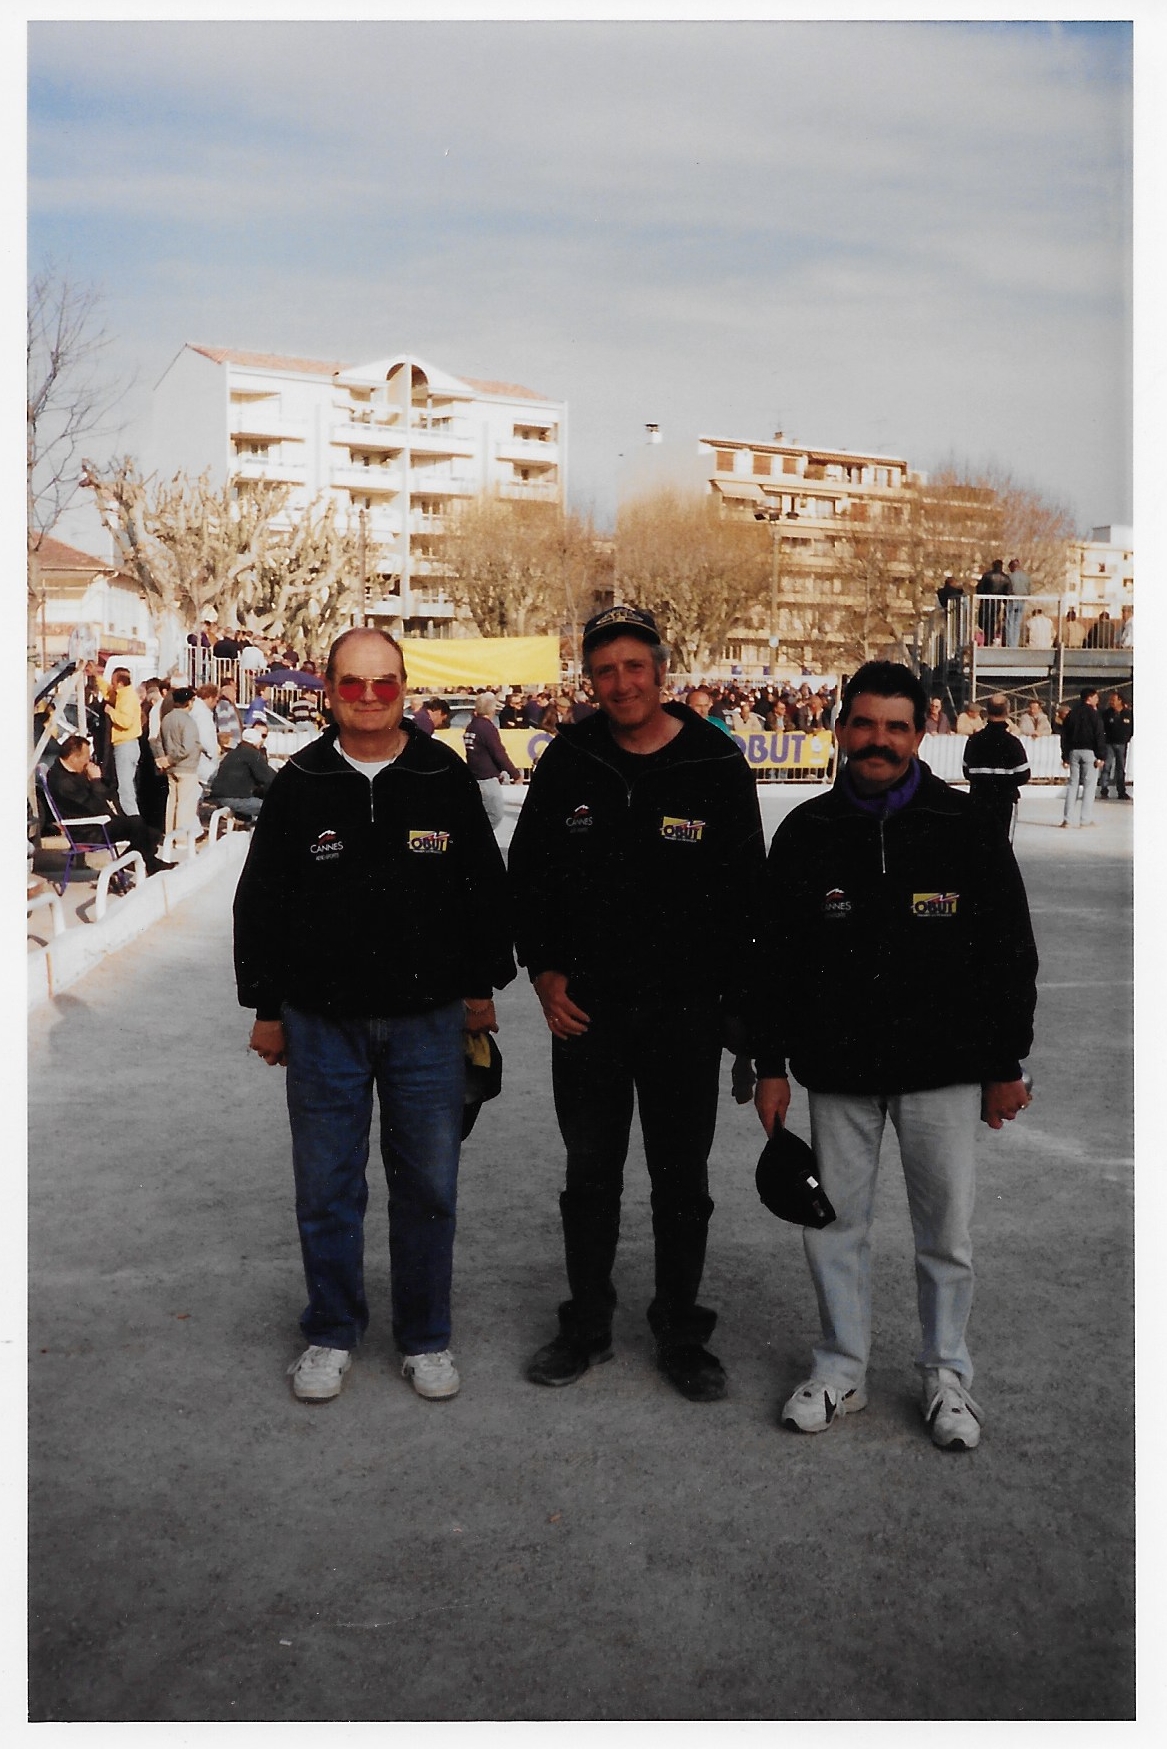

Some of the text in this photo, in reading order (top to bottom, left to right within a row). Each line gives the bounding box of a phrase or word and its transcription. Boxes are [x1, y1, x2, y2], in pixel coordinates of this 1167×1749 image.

[565, 816, 593, 827] CANNES
[664, 824, 702, 840] OBUT
[310, 841, 344, 854] CANNES
[411, 836, 447, 850] OBUT
[914, 899, 956, 914] OBUT
